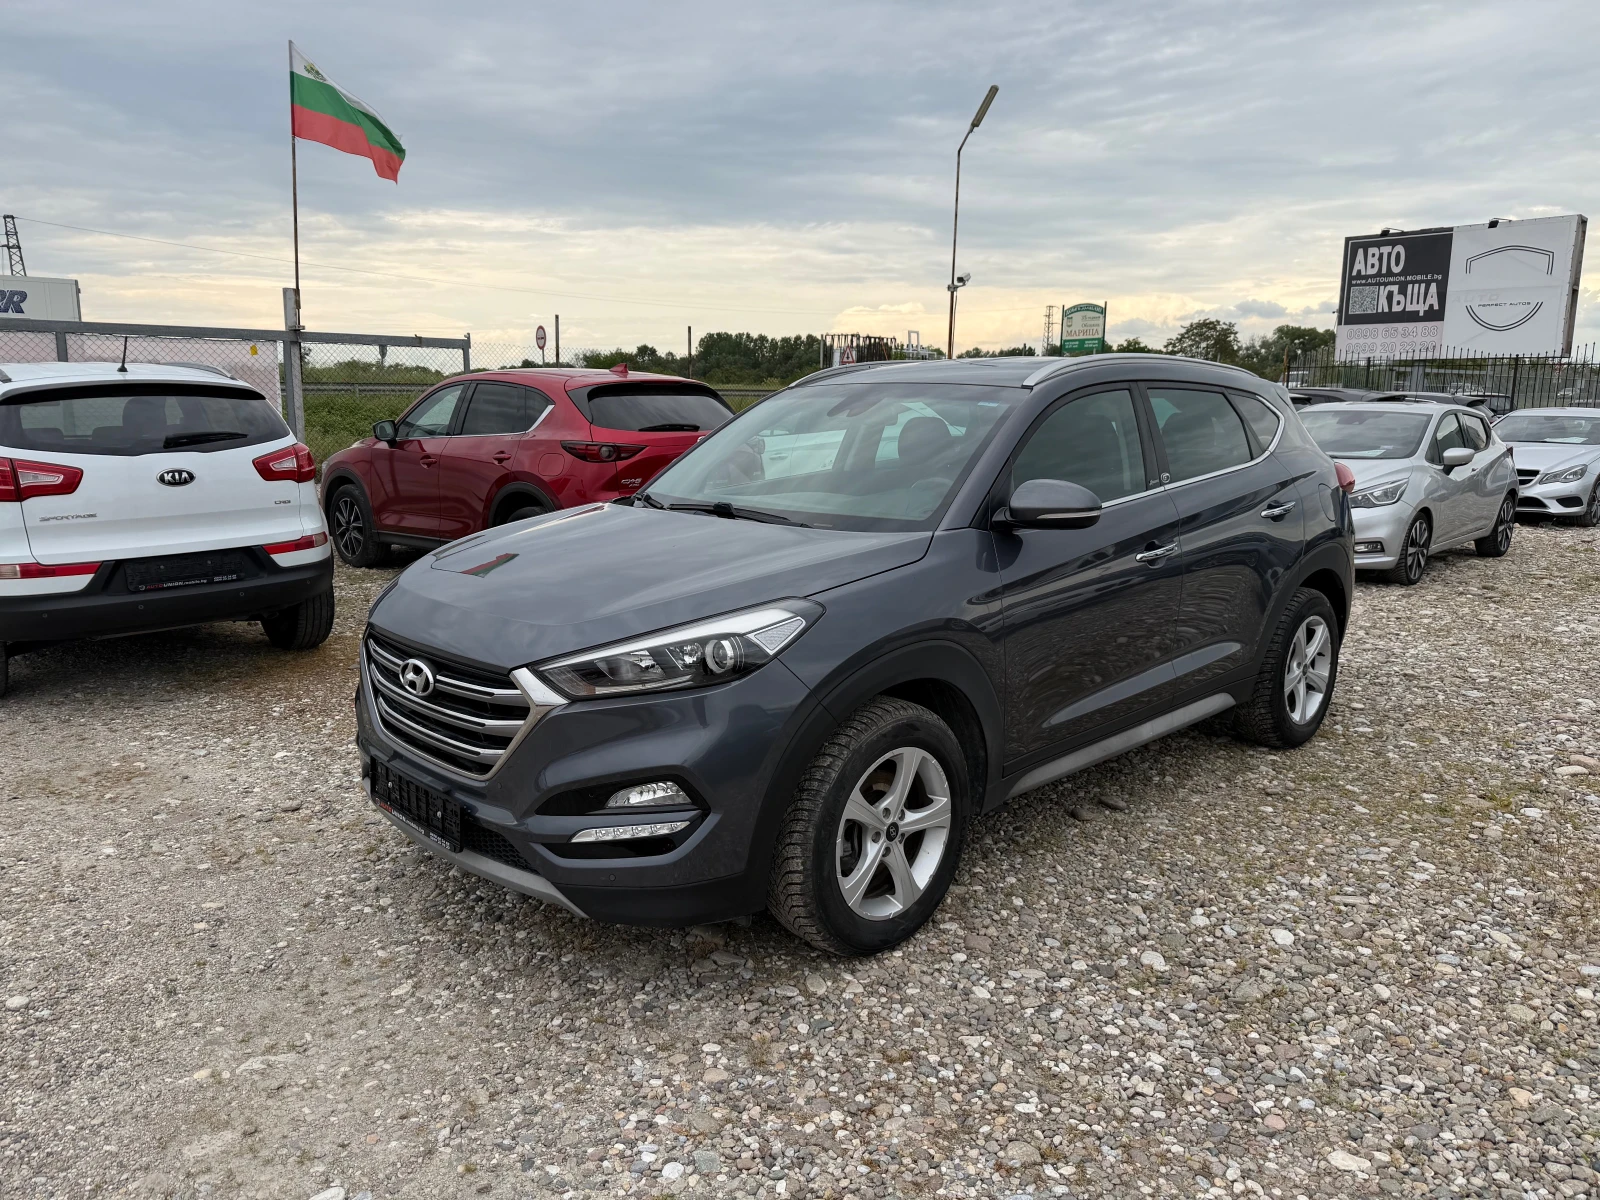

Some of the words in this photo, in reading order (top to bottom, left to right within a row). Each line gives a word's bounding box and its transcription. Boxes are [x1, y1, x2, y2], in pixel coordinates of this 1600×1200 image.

[1351, 244, 1406, 276] АВТО
[1351, 273, 1442, 285] www.AUTOUNION.MOBILE.bg
[1377, 282, 1439, 316] КЪЩА
[1065, 328, 1099, 337] МАРИЦА
[1347, 327, 1378, 340] 0898
[1381, 326, 1399, 339] 65
[1401, 325, 1418, 338] 34
[1421, 325, 1439, 337] 88
[1346, 342, 1377, 354] 0899
[1380, 341, 1397, 353] 20
[1400, 341, 1417, 353] 22
[163, 471, 191, 483] KIA
